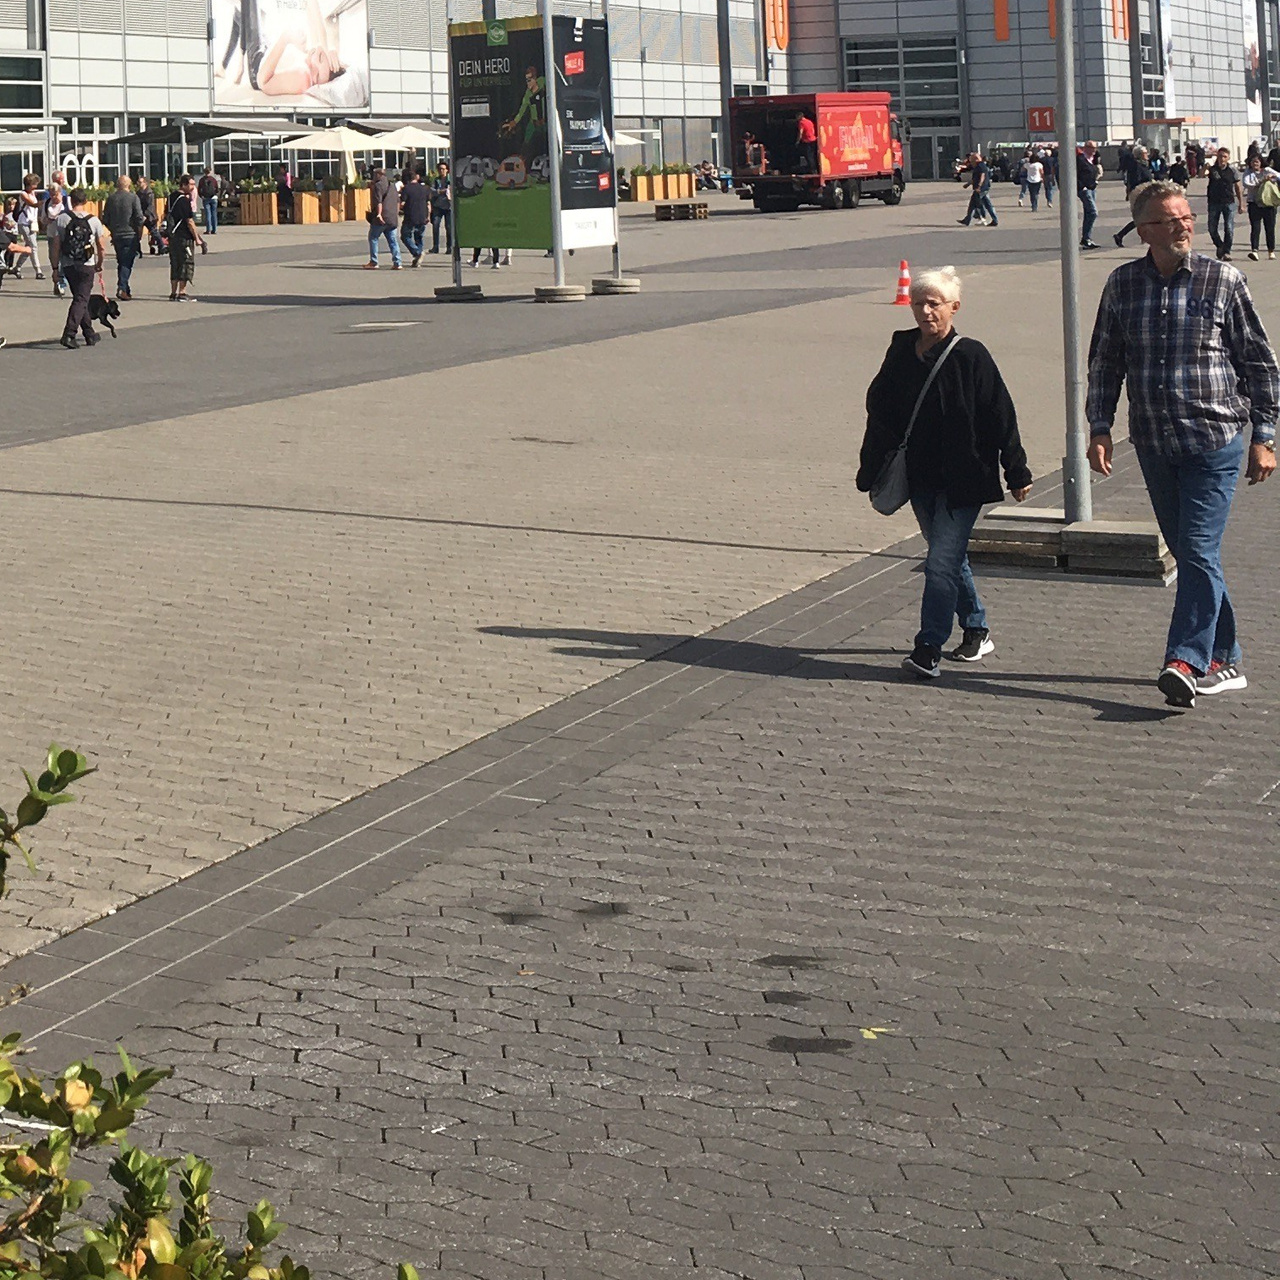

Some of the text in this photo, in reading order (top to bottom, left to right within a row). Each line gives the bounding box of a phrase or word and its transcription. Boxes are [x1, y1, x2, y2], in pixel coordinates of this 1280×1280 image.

[459, 57, 510, 76] DEIN HERO
[1032, 110, 1051, 127] 11
